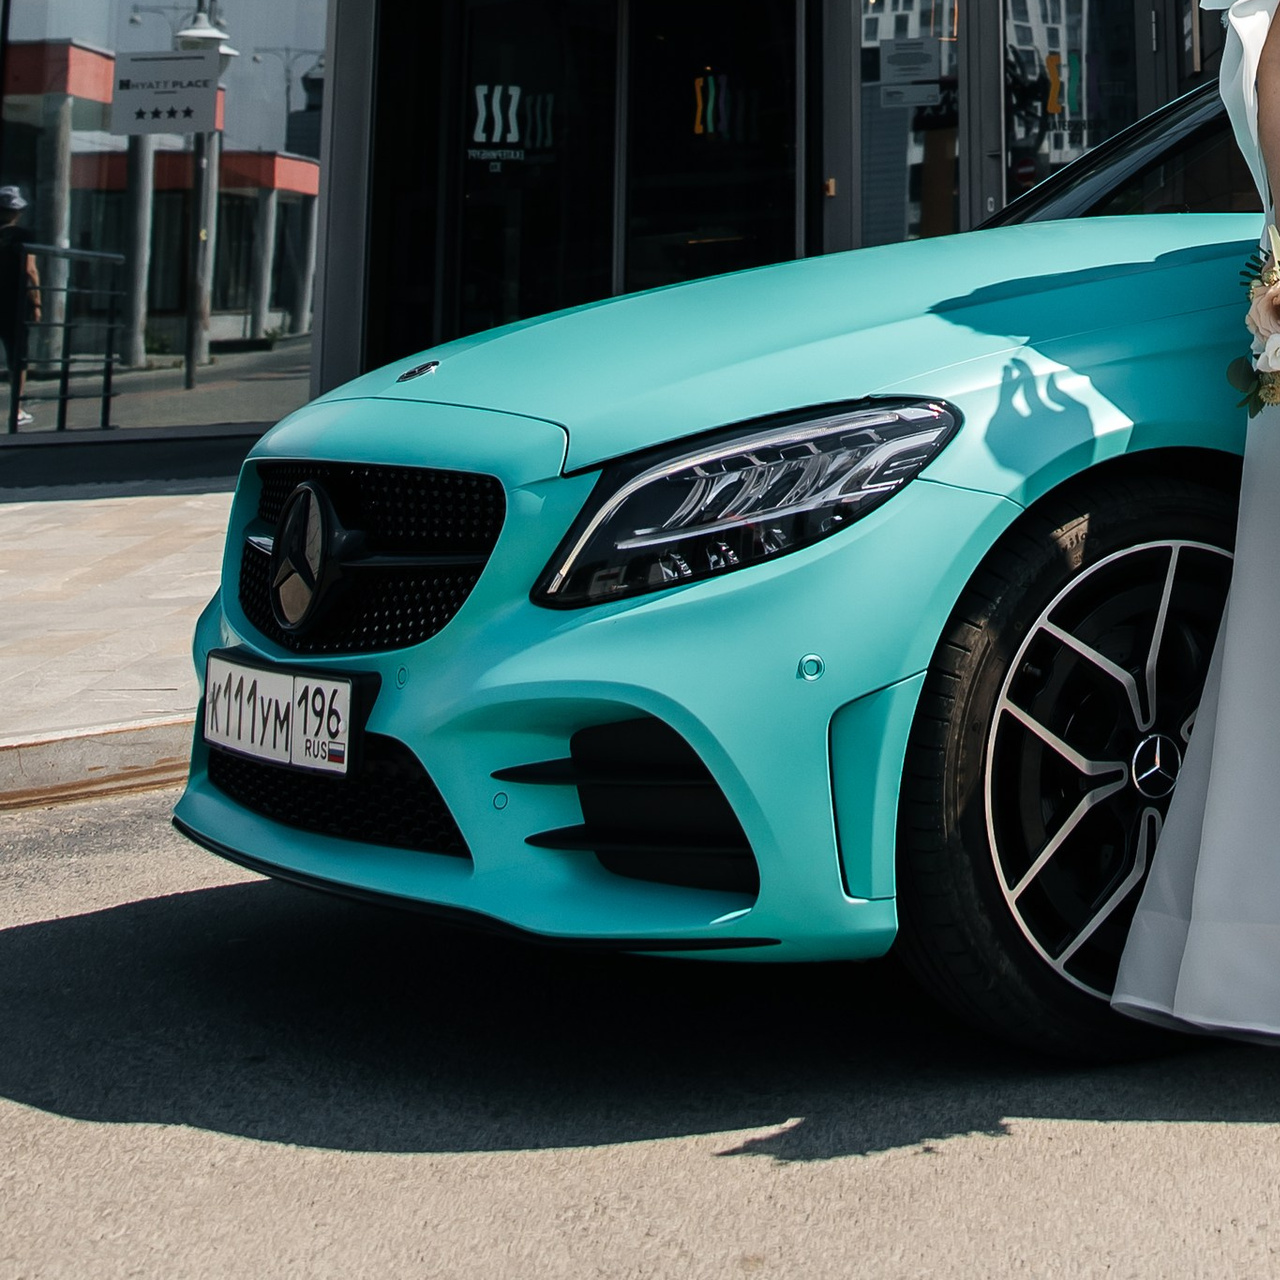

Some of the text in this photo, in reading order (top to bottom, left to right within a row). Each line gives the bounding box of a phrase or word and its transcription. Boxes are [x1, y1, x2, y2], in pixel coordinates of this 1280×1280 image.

[131, 79, 209, 89] HYATT PLACE
[298, 685, 341, 739] 196
[304, 739, 327, 759] RUS
